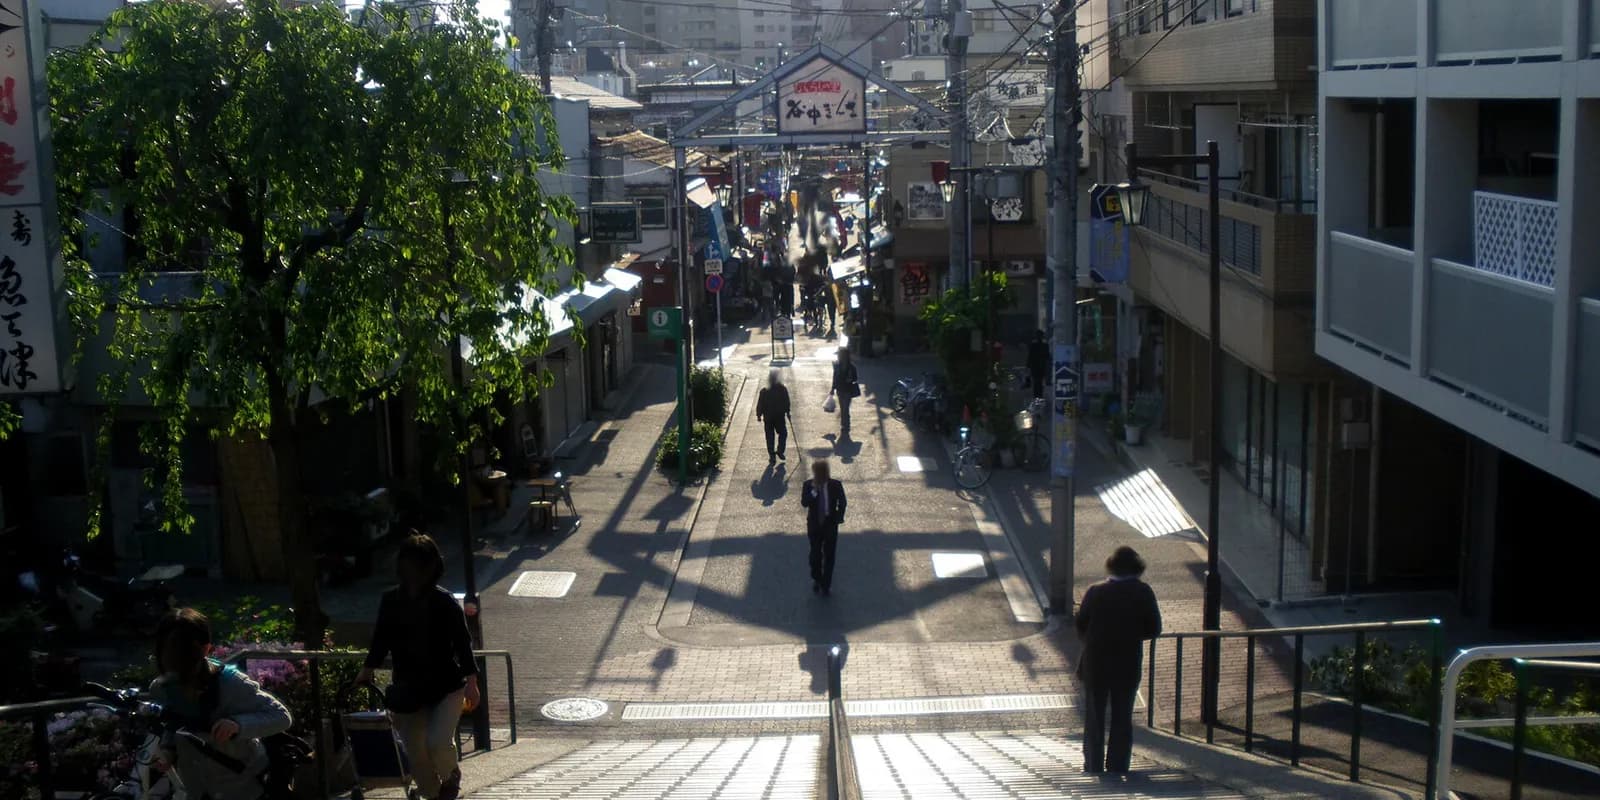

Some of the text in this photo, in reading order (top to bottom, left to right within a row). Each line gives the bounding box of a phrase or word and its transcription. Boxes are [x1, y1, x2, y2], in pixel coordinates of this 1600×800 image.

[786, 89, 858, 126] 谷中ぎんざ
